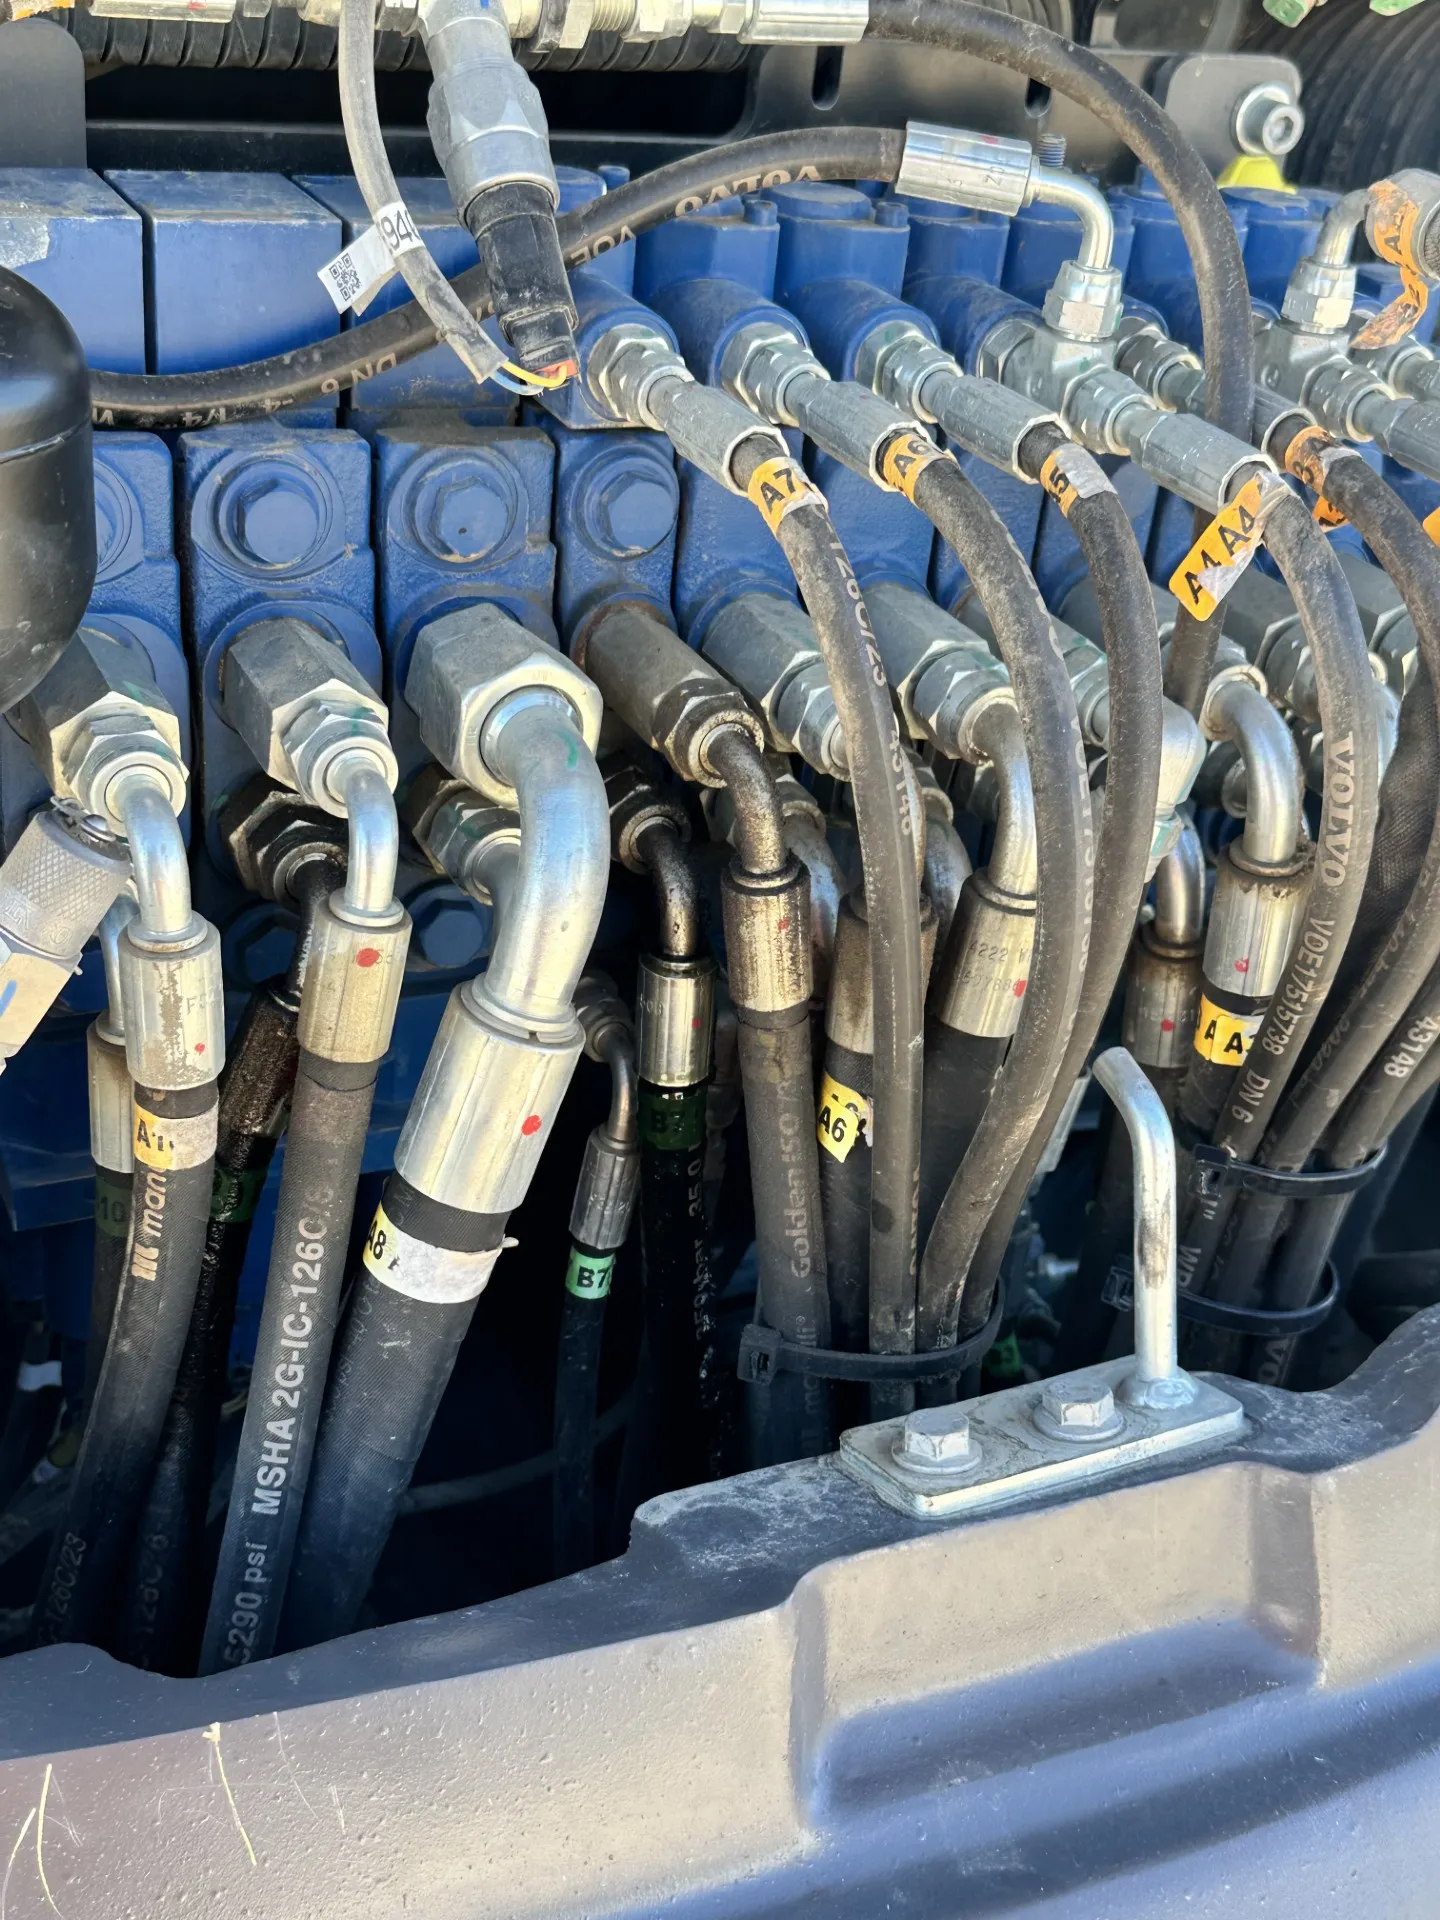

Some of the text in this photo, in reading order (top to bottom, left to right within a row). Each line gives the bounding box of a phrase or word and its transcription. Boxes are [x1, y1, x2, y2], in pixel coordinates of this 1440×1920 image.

[675, 165, 821, 217] VOLVO
[760, 467, 797, 513] A7
[1218, 504, 1257, 557] A4
[1320, 731, 1356, 888] VOLVO
[1262, 916, 1336, 1056] VOE17515738
[1383, 1015, 1440, 1079] 43148
[1231, 1104, 1255, 1124] 6
[1238, 1069, 1272, 1107] DN
[818, 1105, 848, 1143] A6
[250, 1416, 297, 1516] MSHA
[243, 1541, 268, 1584] psi
[223, 1591, 263, 1664] 5290
